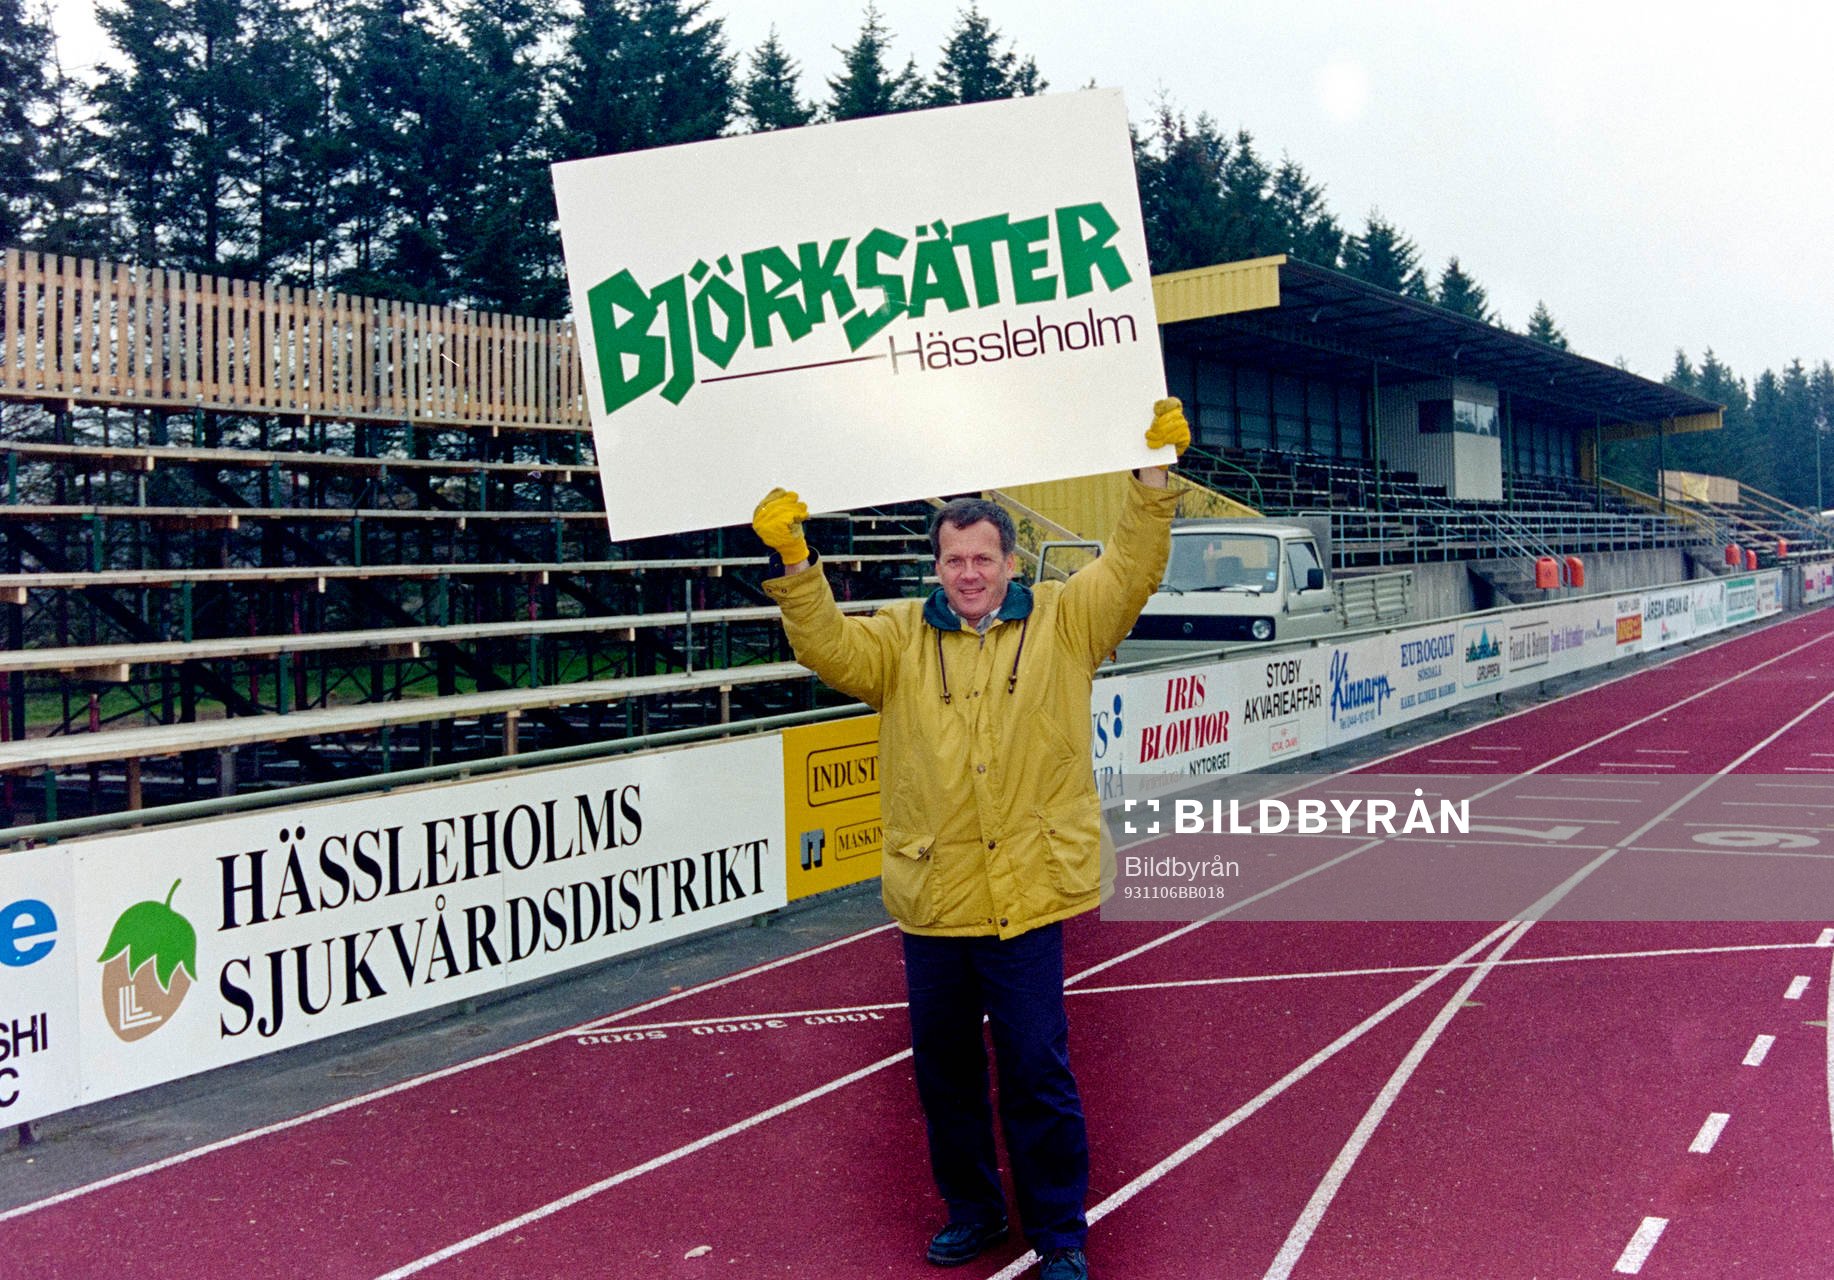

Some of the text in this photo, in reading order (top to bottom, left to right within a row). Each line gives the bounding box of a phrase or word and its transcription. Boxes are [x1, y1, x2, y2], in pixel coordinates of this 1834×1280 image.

[586, 201, 1133, 416] BJÖRKSÄTER
[888, 308, 1138, 376] Hässleholm
[1266, 659, 1302, 689] STOBY
[1400, 633, 1455, 668] EUROGOLV
[1477, 662, 1500, 681] GRUPPEN
[1164, 672, 1207, 713] IRIS
[1243, 678, 1322, 724] AKVARIEAFFÄR
[1330, 650, 1396, 722] Kinnarps
[1139, 709, 1231, 765] BLOMMOR
[1189, 751, 1231, 778] NYTORGET
[216, 783, 643, 931] HÄSSLEHOLMS
[219, 838, 769, 1040] SJUKVÅRDSDISTRIKT
